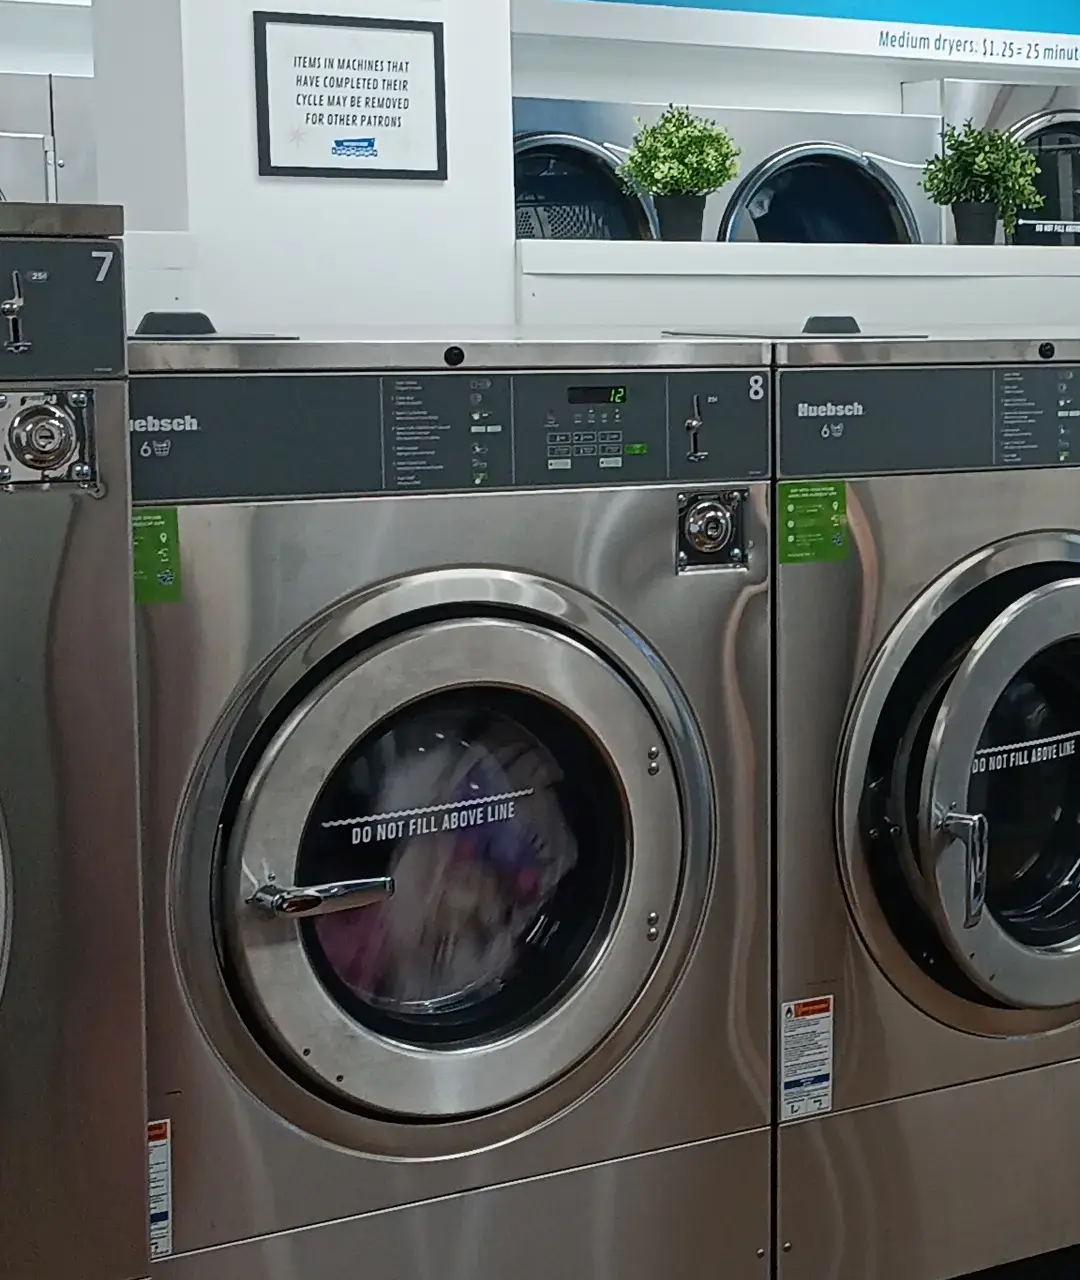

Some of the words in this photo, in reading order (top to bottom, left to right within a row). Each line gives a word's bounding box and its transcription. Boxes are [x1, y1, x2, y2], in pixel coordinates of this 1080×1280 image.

[878, 30, 930, 48] Medium
[293, 56, 321, 69] ITEMS
[323, 58, 335, 70] IN
[337, 58, 384, 72] MACHINES
[387, 60, 410, 73] THAT
[296, 75, 321, 88] HAVE
[323, 76, 378, 90] COMPLETED
[381, 78, 409, 91] THEIR
[296, 93, 325, 106] CYCLE
[327, 95, 348, 108] MAY
[350, 96, 362, 108] BE
[364, 96, 410, 109] REMOVED
[305, 112, 325, 126] FOR
[327, 113, 358, 127] OTHER
[360, 114, 402, 128] PATRONS
[91, 251, 114, 282] 7
[609, 388, 625, 403] 12
[749, 375, 764, 400] 8
[798, 402, 864, 417] Huebsch
[821, 423, 831, 438] 6
[140, 440, 152, 457] 6
[972, 758, 986, 774] DO
[988, 753, 1009, 771] NOT
[1009, 750, 1030, 768] FILL
[1030, 744, 1058, 764] ABOVE
[1058, 739, 1076, 757] LINE
[352, 826, 372, 845] DO
[376, 821, 405, 841] NOT
[409, 815, 438, 836] FILL
[442, 807, 484, 831] ABOVE
[487, 801, 515, 823] LINE
